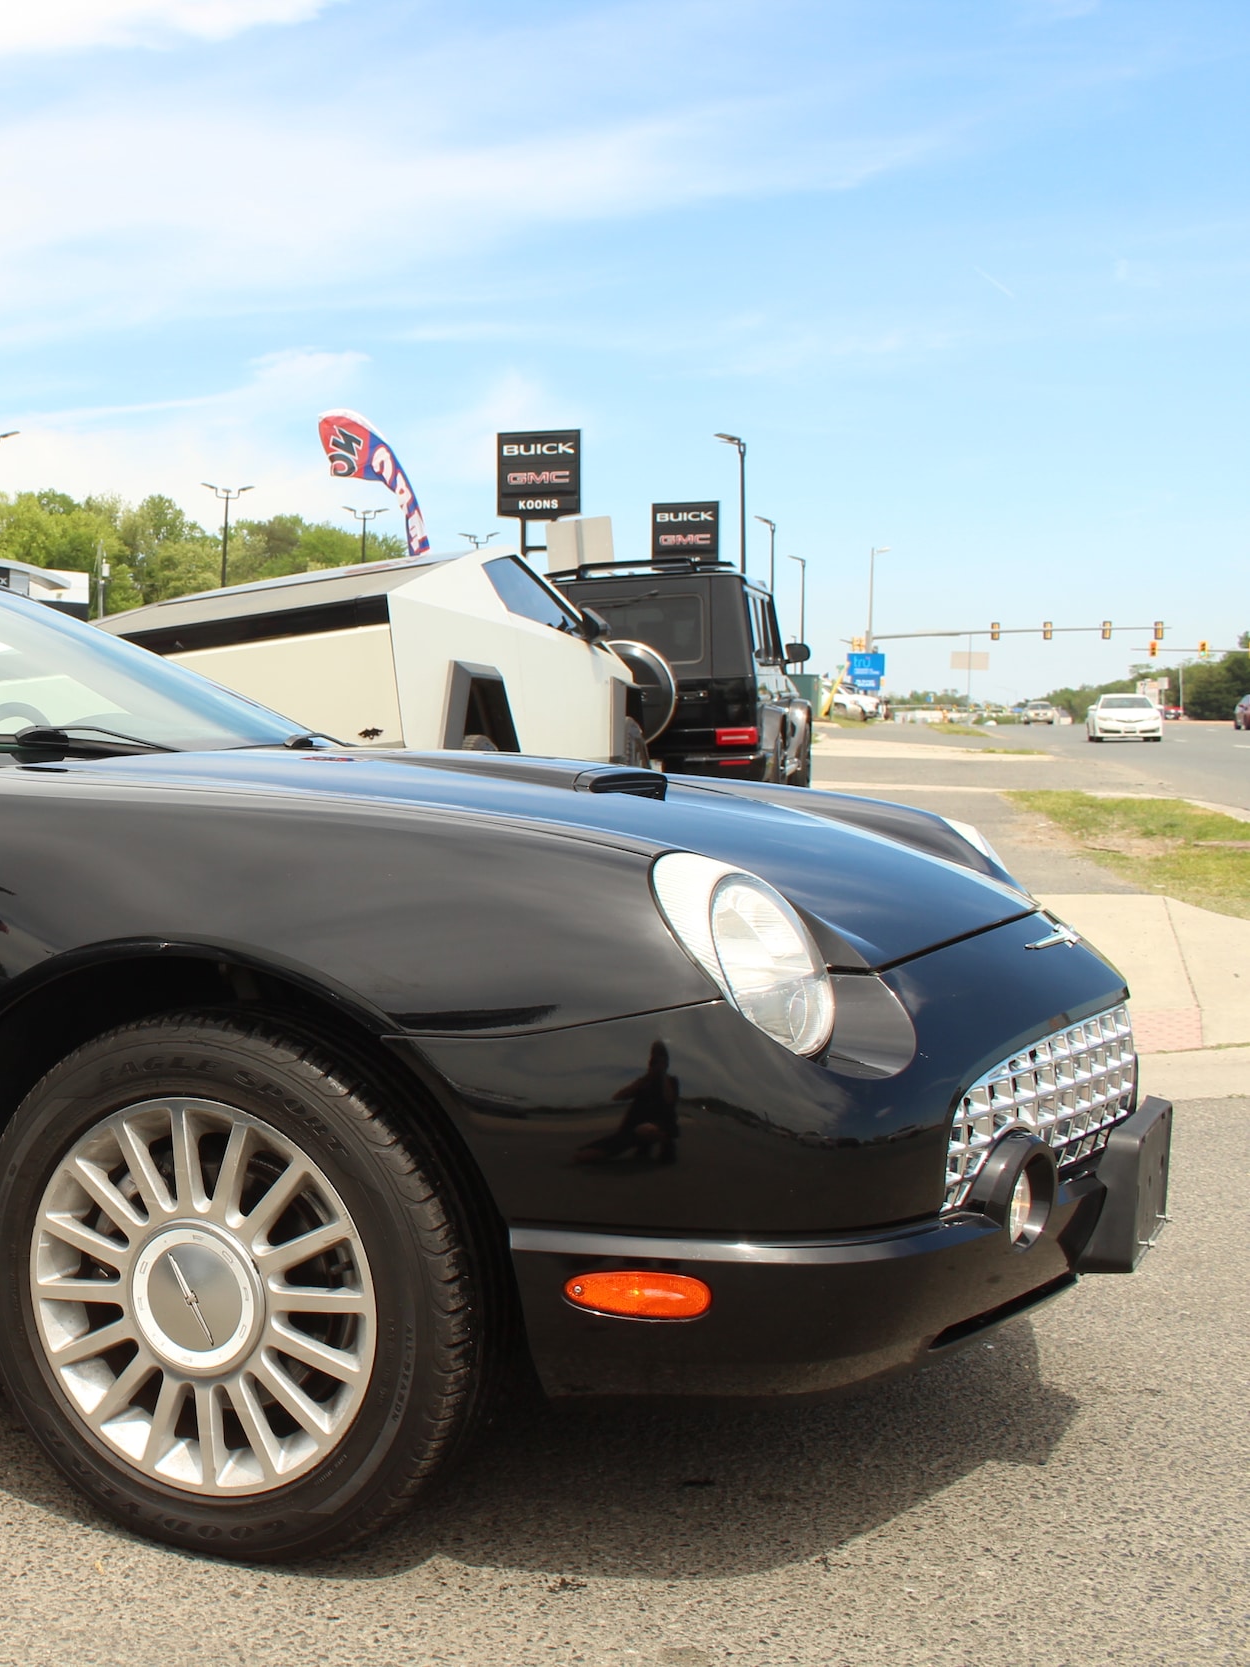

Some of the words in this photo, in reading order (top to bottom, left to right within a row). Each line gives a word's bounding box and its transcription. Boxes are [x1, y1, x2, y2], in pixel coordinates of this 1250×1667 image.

[503, 442, 575, 457] BUICK
[507, 470, 570, 485] GMC
[518, 499, 559, 510] KOONS
[656, 511, 714, 522] BUICK
[659, 534, 711, 546] GMC
[99, 1055, 221, 1083] EAGLE
[232, 1070, 352, 1158] SPORT
